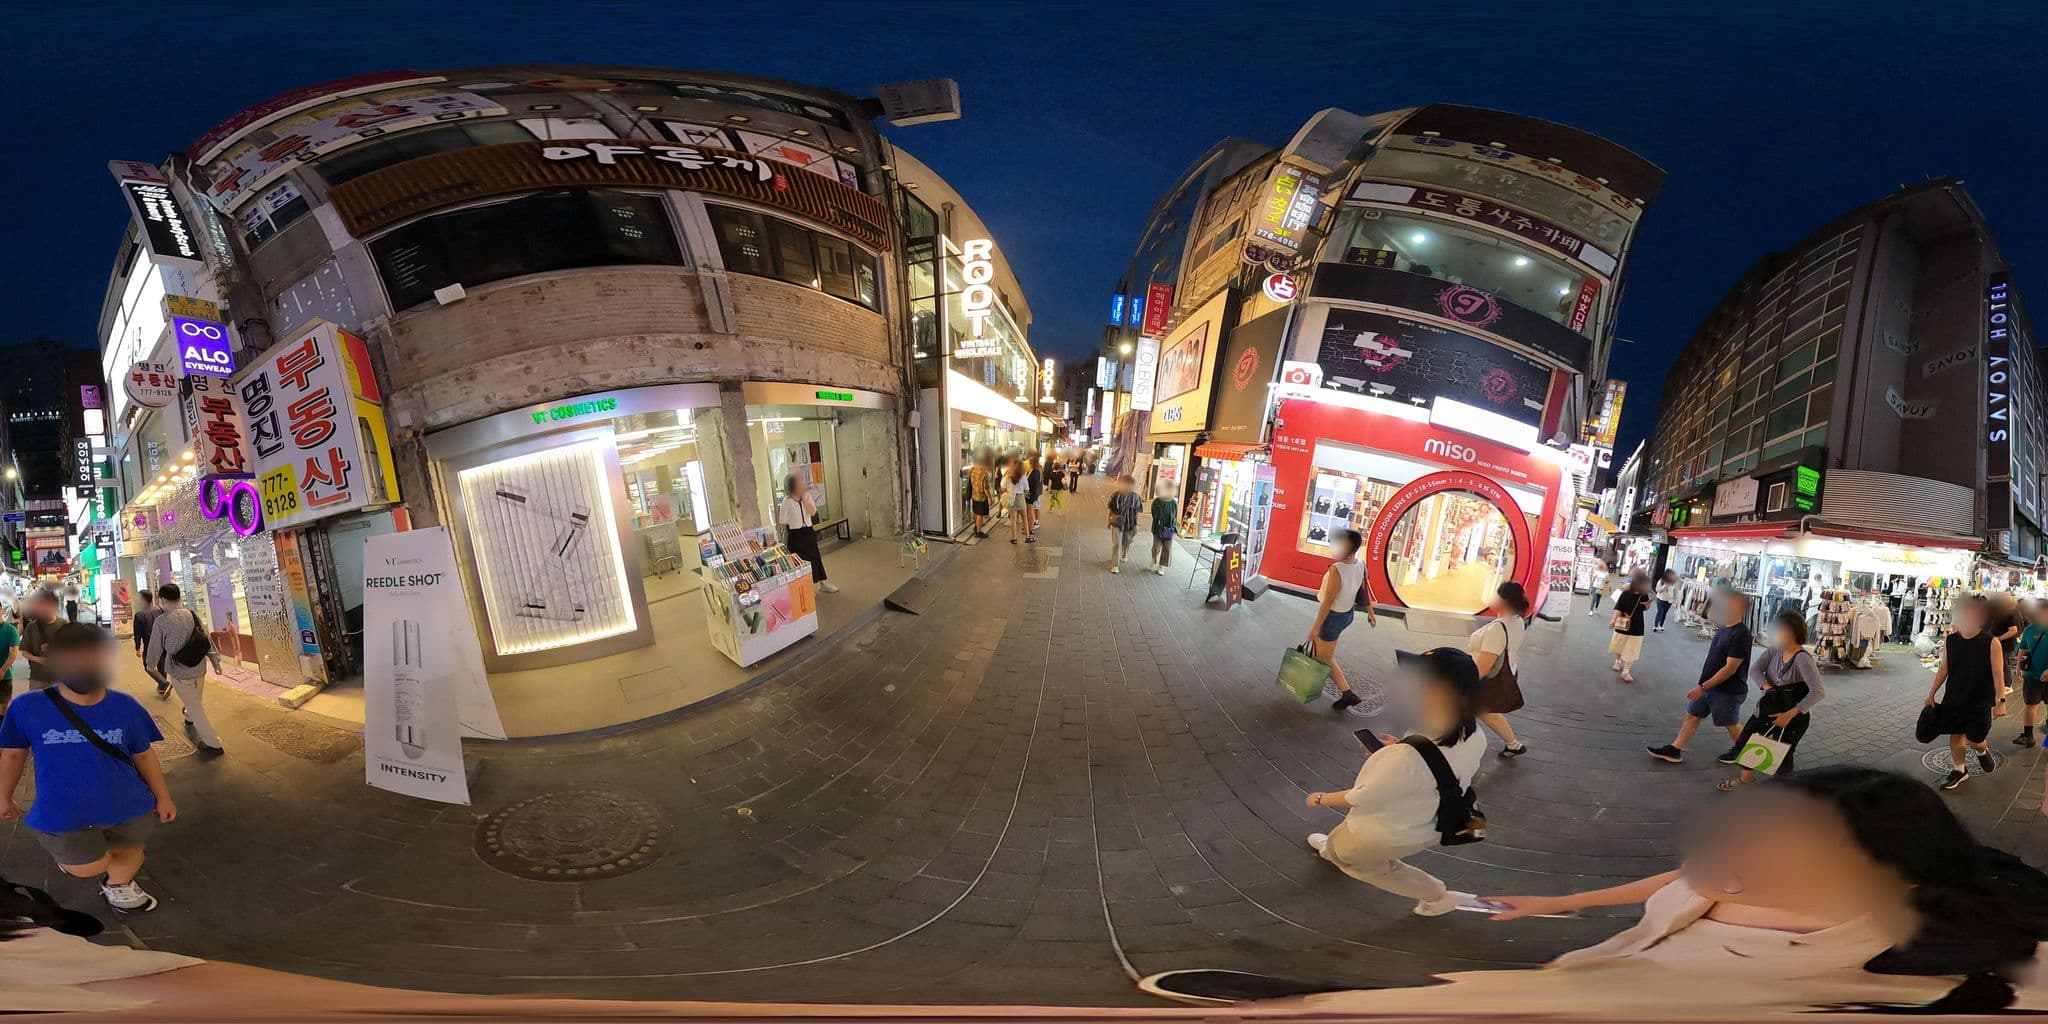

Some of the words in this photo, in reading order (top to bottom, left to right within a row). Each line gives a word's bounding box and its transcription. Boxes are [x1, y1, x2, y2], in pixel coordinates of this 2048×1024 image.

[961, 239, 993, 336] ROOT
[1274, 276, 1295, 298] 占
[1990, 283, 2007, 339] HOTEL
[185, 346, 230, 364] ALO
[1888, 336, 1920, 354] SAVOY
[185, 361, 231, 374] EYEWEAR
[1928, 346, 1976, 373] SAVOY
[131, 372, 176, 389] 부동산
[533, 412, 549, 425] VT
[551, 398, 618, 421] COSMETICS
[1890, 394, 1929, 417] SAVOY
[1989, 356, 2008, 443] SAVOY
[241, 371, 284, 460] 명진
[276, 337, 351, 508] 부동산
[200, 395, 246, 473] 부동산
[1424, 438, 1476, 462] miso
[262, 475, 289, 496] 777-
[266, 493, 297, 517] 8128
[1373, 532, 1384, 561] K-PHOTO
[1381, 511, 1393, 531] ZOOM
[1392, 498, 1407, 512] LENS
[1552, 544, 1572, 554] miso
[366, 577, 406, 588] REEDLE
[408, 573, 441, 586] SHOT
[381, 763, 447, 783] INTENSITY
